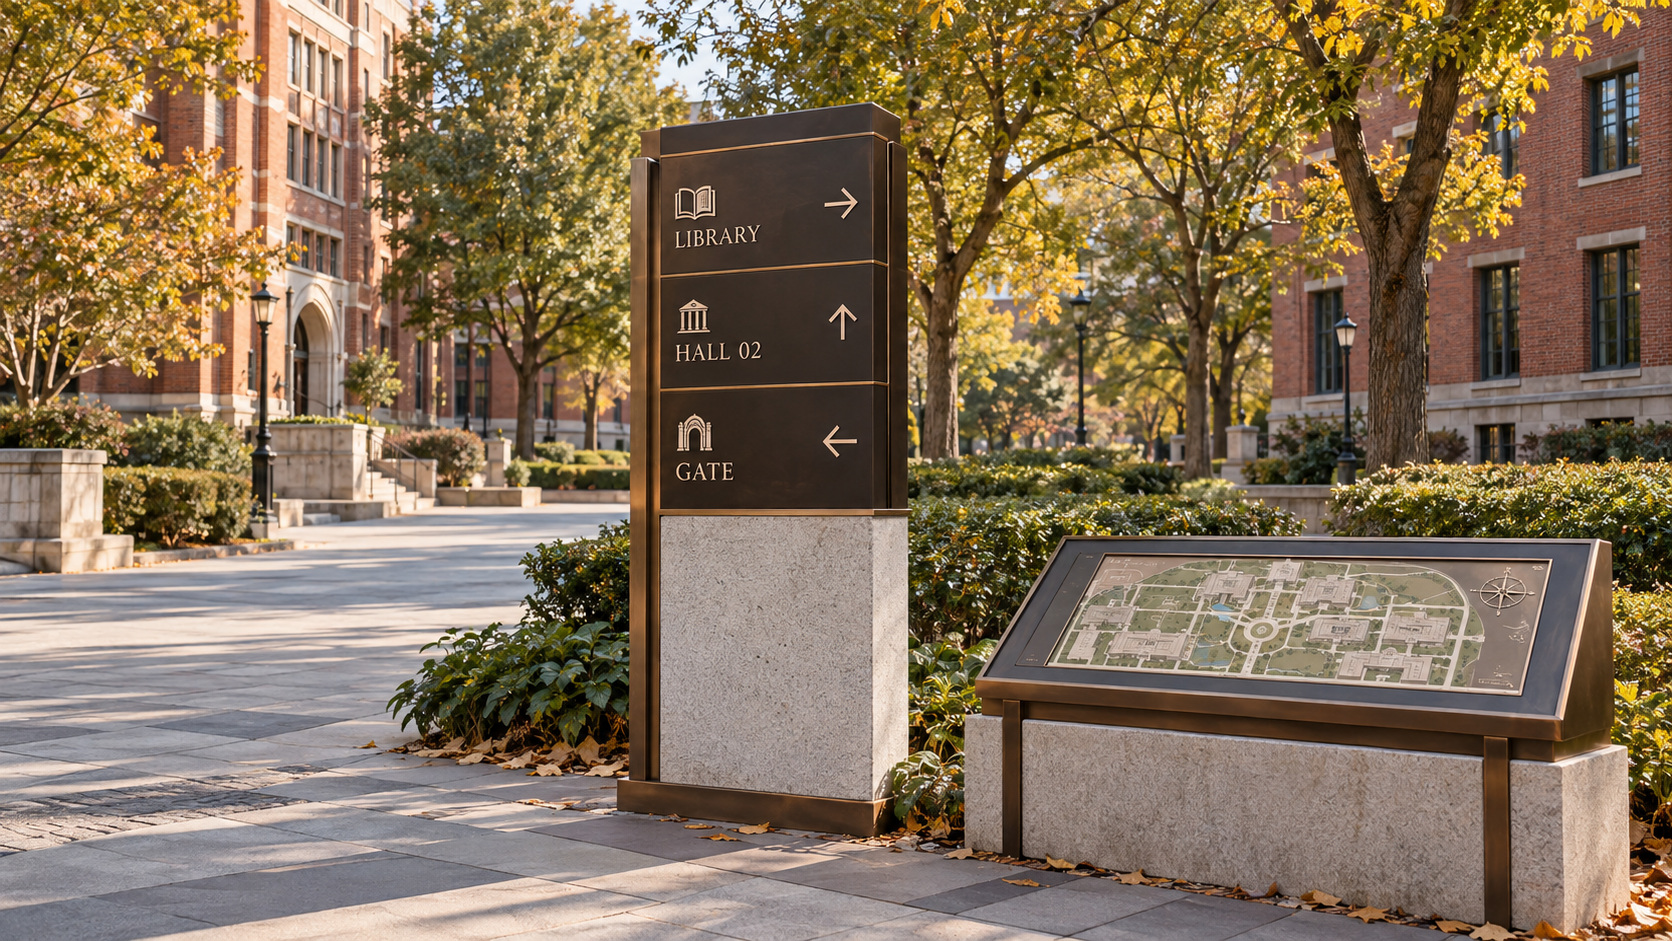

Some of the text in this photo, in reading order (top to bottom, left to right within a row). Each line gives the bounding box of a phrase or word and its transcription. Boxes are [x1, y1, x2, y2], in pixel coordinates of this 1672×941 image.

[674, 224, 761, 249] LIBRARY
[675, 341, 762, 362] HALL 02
[675, 462, 734, 481] GATE
